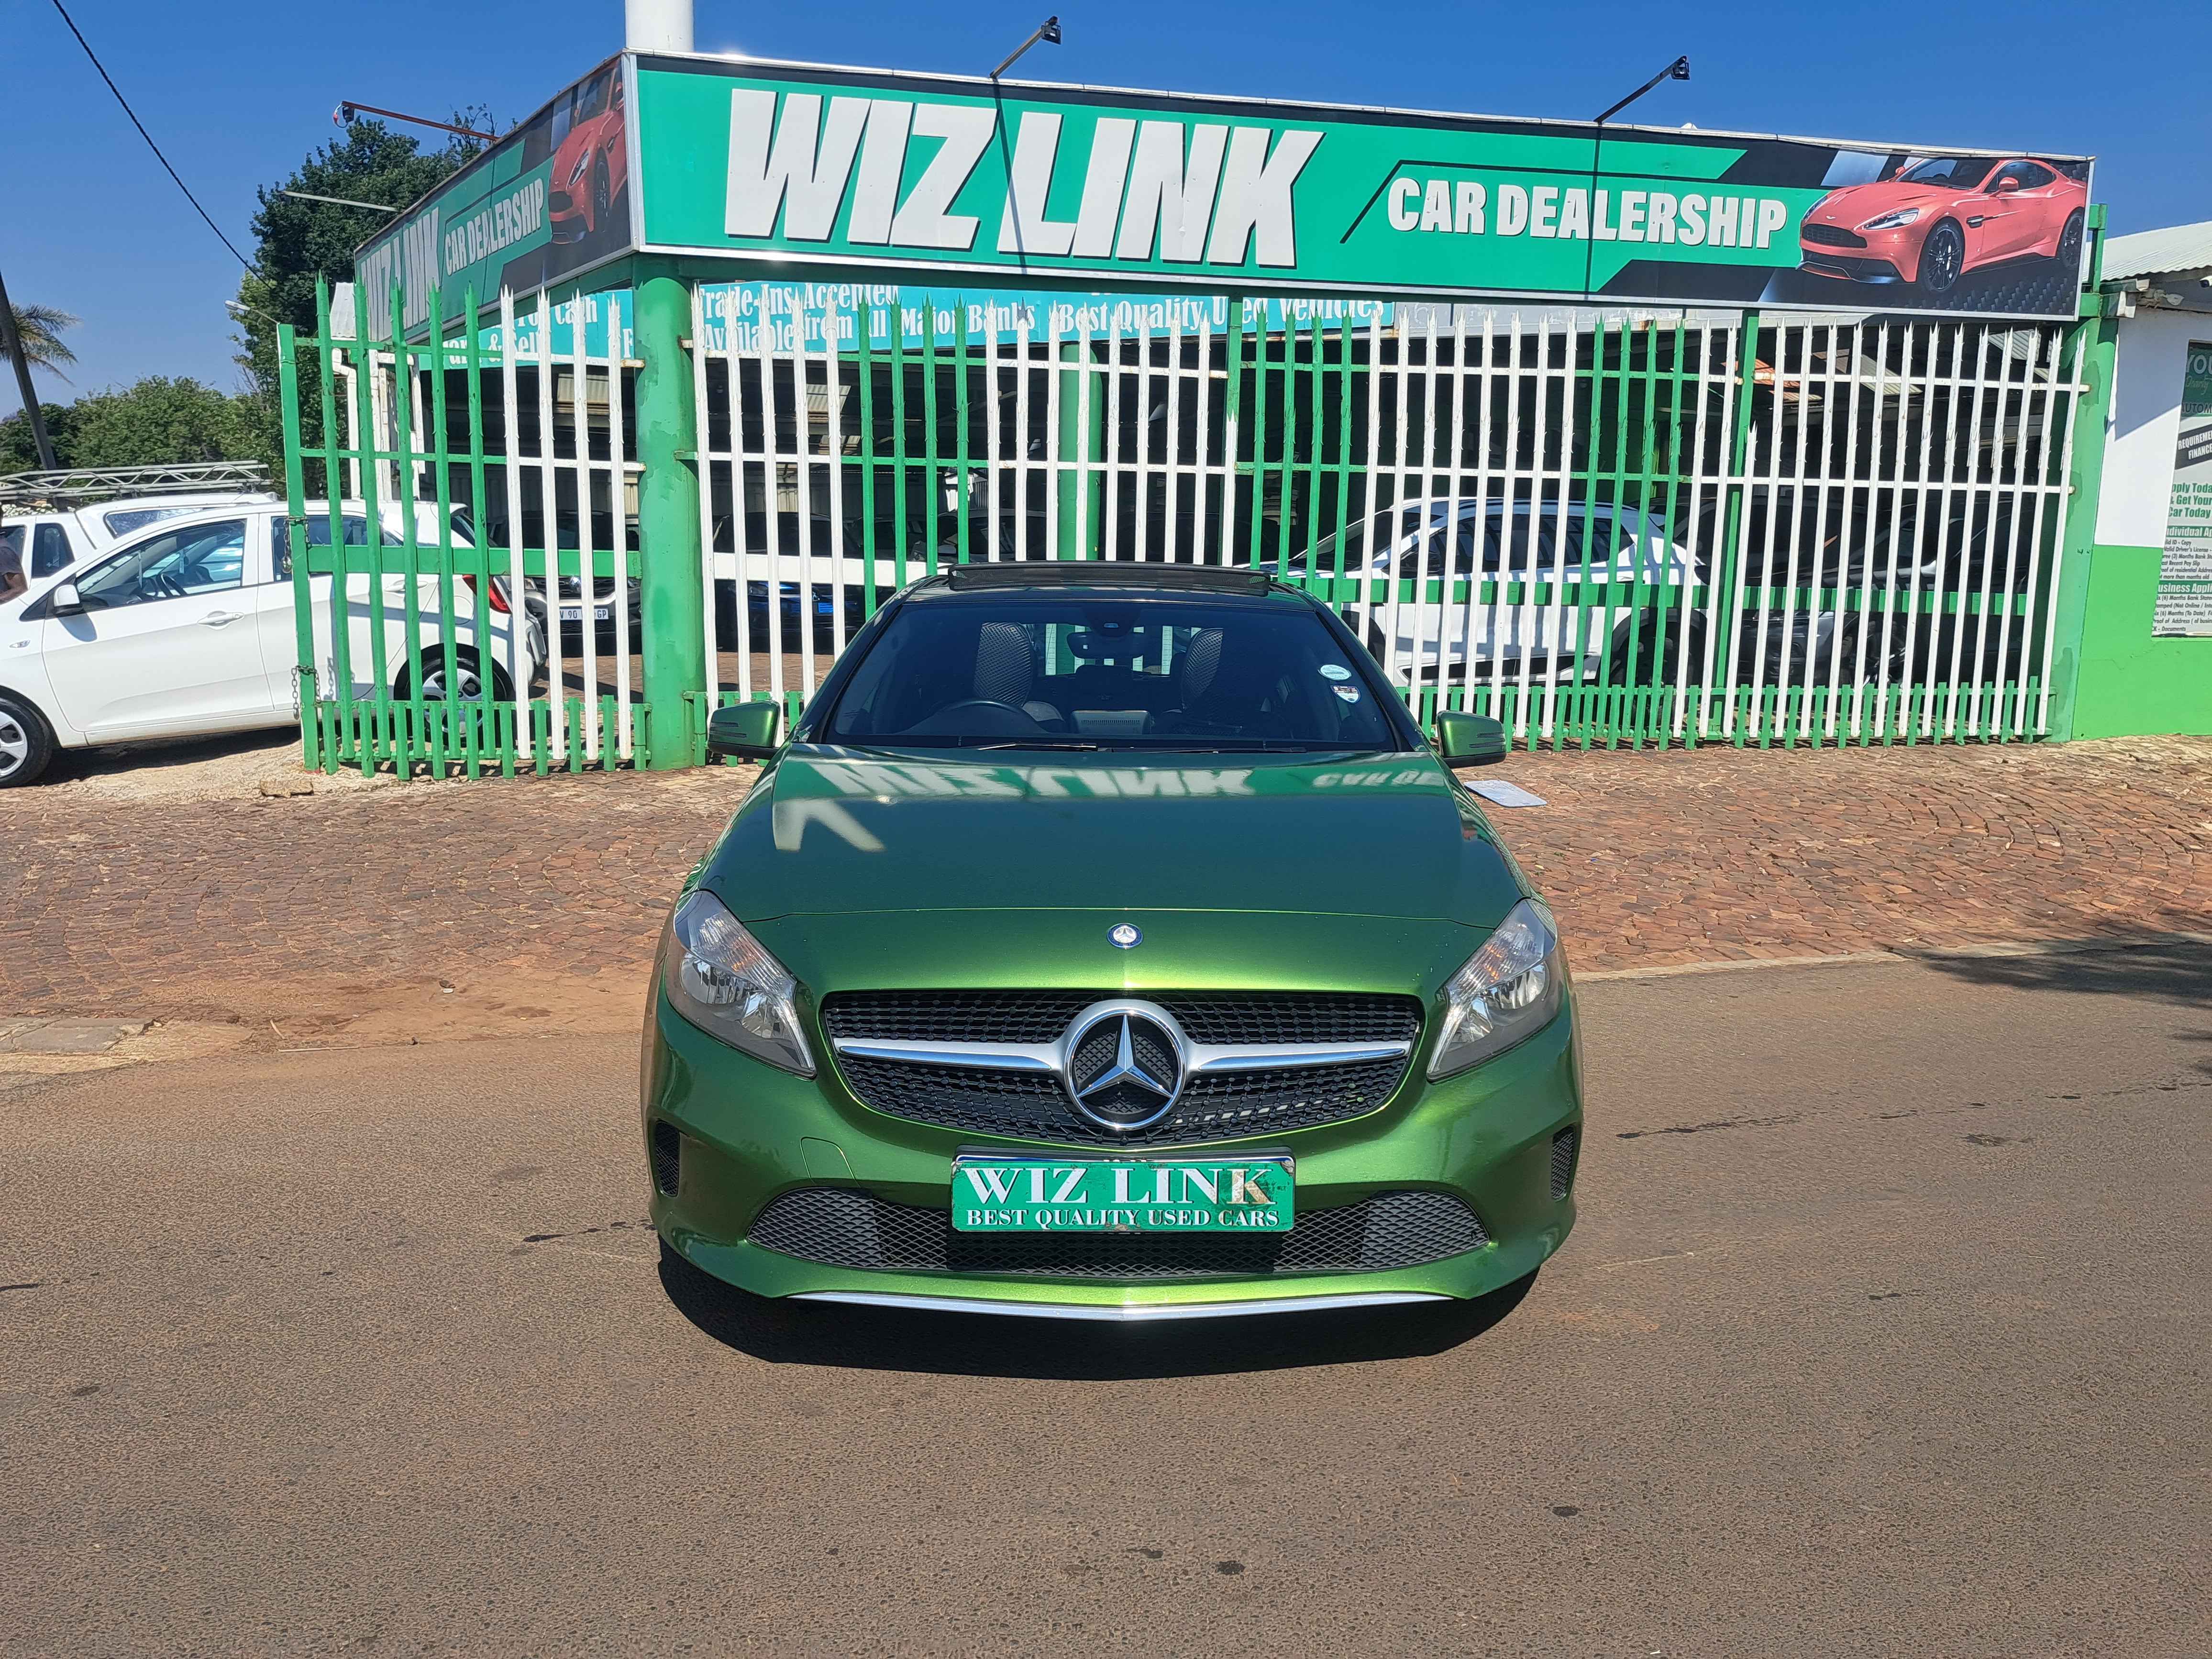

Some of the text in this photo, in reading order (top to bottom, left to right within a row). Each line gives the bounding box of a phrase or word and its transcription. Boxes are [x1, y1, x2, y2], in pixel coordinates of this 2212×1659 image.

[725, 88, 1325, 268] WIZ LINK
[1387, 177, 1788, 250] CAR DEALERSHIP
[445, 177, 544, 276] CAR DEALERSHIP
[2176, 494, 2192, 505] Get
[2168, 506, 2211, 519] Car Today
[2158, 583, 2191, 593] usiness
[597, 610, 607, 618] GP
[962, 1167, 1278, 1206] WIZ LINK
[966, 1209, 1280, 1230] BEST QUALITY USED CARS
